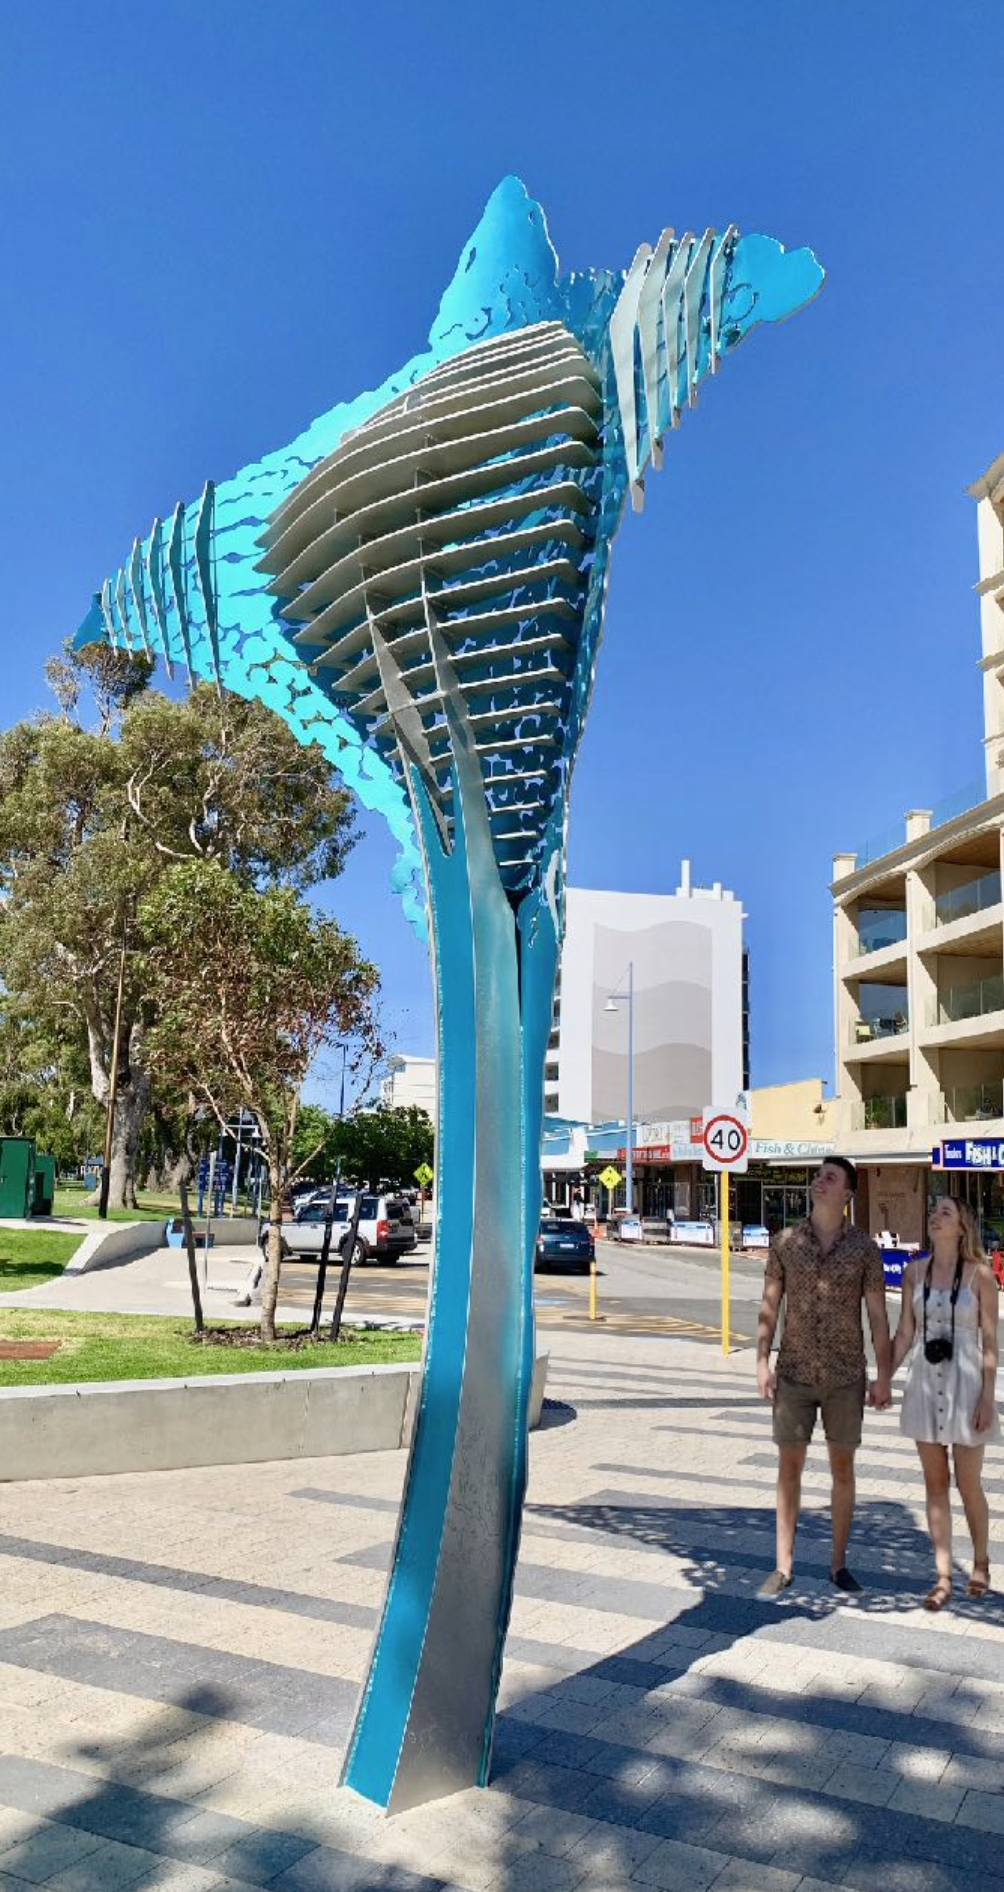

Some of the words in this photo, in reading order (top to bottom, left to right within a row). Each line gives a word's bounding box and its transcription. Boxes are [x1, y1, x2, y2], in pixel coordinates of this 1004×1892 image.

[710, 1129, 741, 1151] 40
[755, 1141, 782, 1154] Fish
[783, 1143, 794, 1155] &
[965, 1141, 992, 1165] FISH
